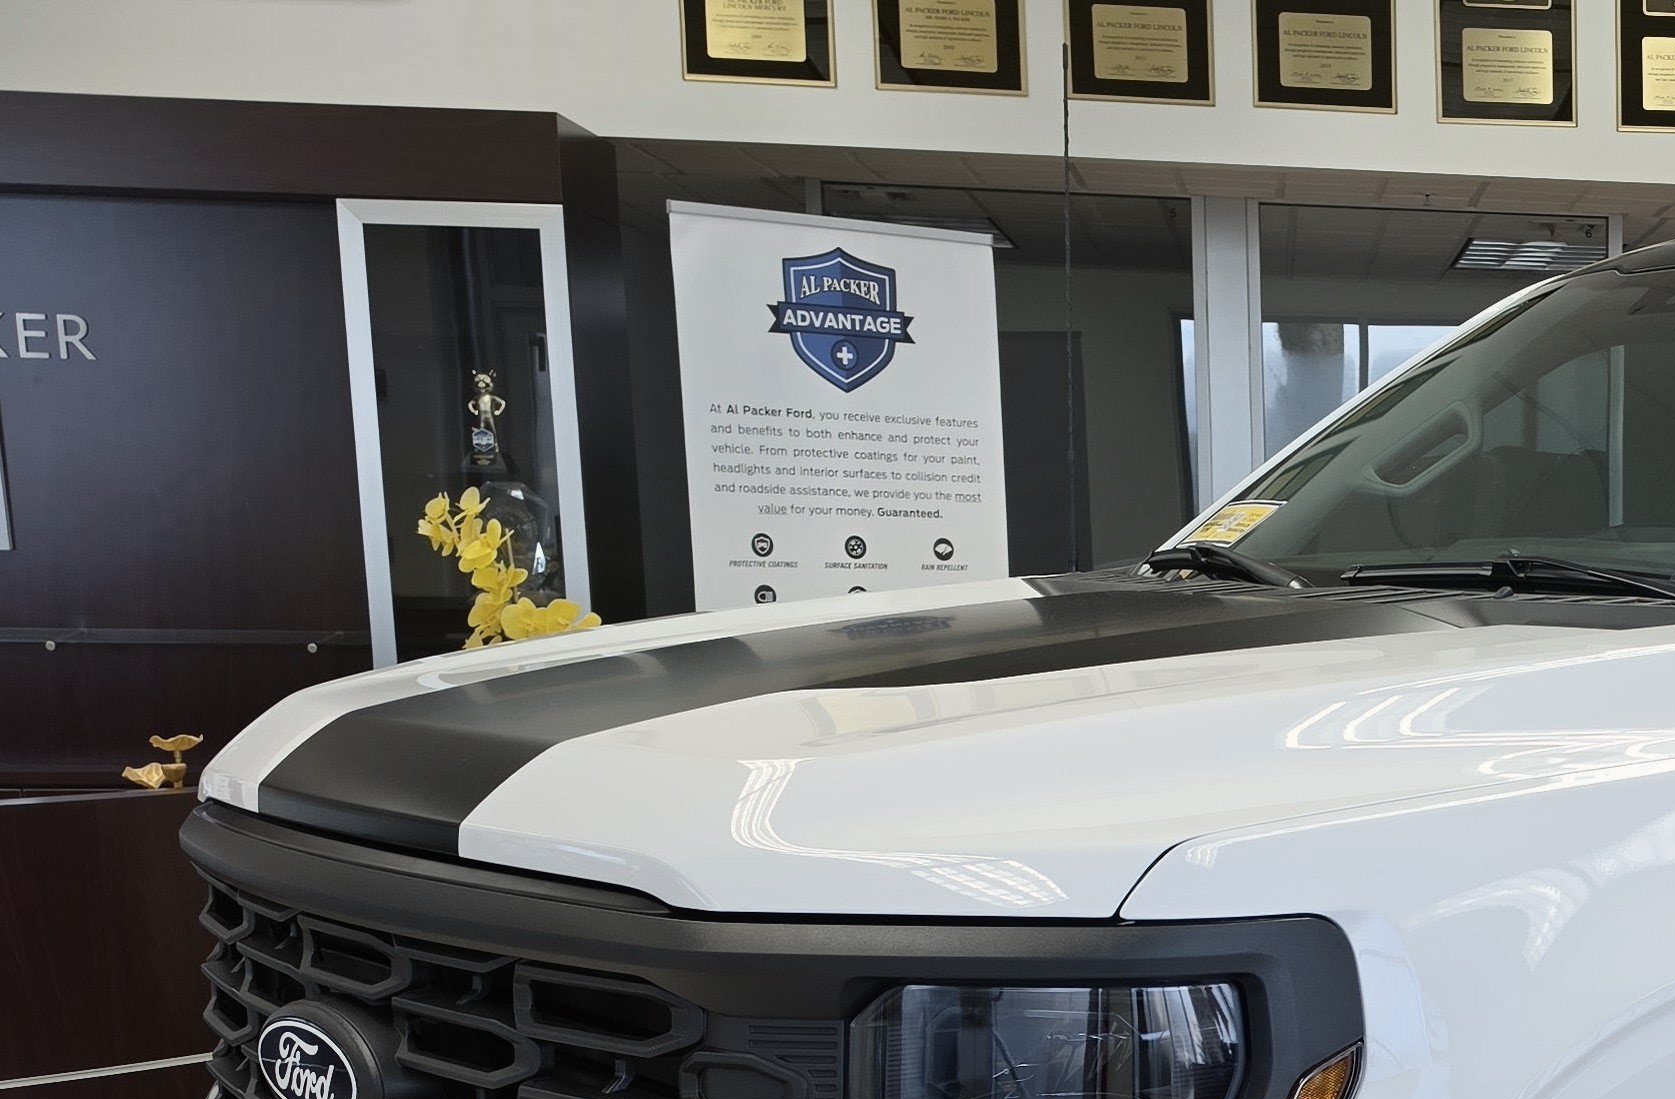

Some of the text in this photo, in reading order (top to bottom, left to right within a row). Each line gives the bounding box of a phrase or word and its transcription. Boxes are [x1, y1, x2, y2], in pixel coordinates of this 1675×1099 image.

[800, 275, 880, 305] AL PACKER
[783, 309, 902, 333] ADVANTAGE
[710, 404, 979, 428] At Al Packer Ford, you receive exclusive features
[711, 424, 979, 447] and benefits to both enhance and protect your
[711, 443, 753, 454] vehicle.
[760, 445, 788, 456] From
[793, 447, 849, 459] protective
[854, 451, 898, 463] coatings
[904, 453, 918, 462] for
[923, 455, 945, 465] your
[713, 462, 981, 484] headlights and interior surfaces to collision credit
[714, 483, 981, 502] and roadside assistance, we provide you the most
[758, 502, 788, 514] value
[791, 504, 805, 514] for
[809, 506, 832, 516] your
[877, 507, 943, 519] Guaranteed.
[729, 560, 766, 568] PROTECTIVE
[854, 562, 888, 570] SANITATION
